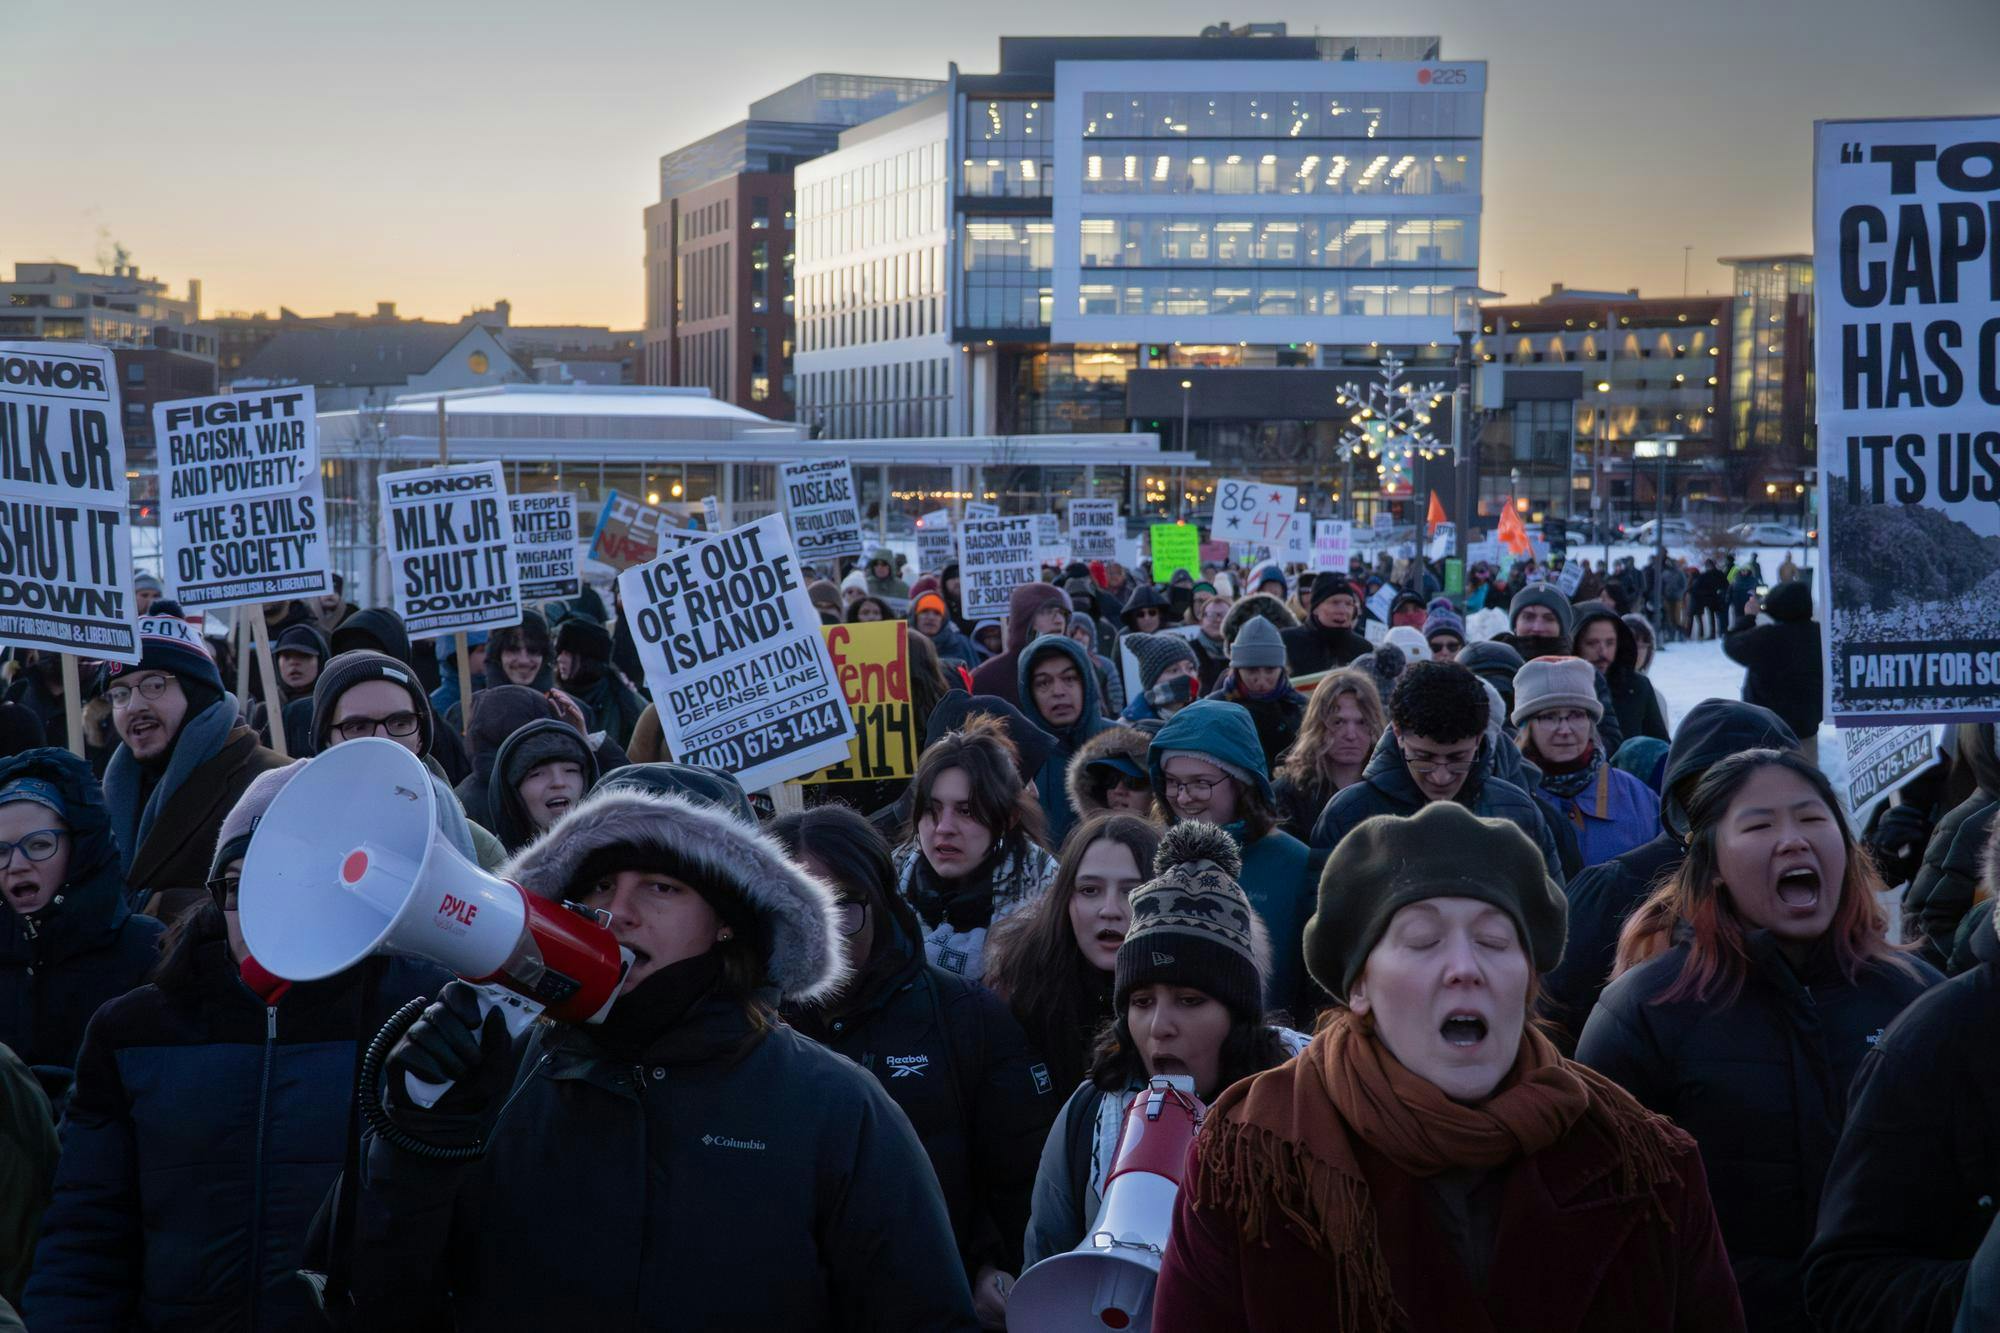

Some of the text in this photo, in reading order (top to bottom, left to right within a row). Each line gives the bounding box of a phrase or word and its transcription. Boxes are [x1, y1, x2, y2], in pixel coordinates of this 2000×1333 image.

[1432, 68, 1467, 85] 225
[0, 357, 106, 392] ONOR
[1842, 320, 1963, 410] HAS
[166, 394, 303, 432] FIGHT
[61, 408, 115, 491] JR
[169, 420, 305, 466] RACISM, WAR
[171, 455, 305, 499] AND POVERTY:
[786, 459, 846, 476] RACISM
[1846, 433, 1926, 506] ITS
[390, 474, 493, 498] HONOR
[790, 478, 851, 507] DISEASE
[1221, 483, 1259, 511] 86
[174, 496, 316, 544] “THE 3 EVILS
[524, 496, 571, 511] PEOPLE
[609, 496, 679, 532] ICE
[1088, 511, 1114, 527] KING
[393, 498, 500, 552] MLK JR
[529, 530, 573, 543] DEFEND
[798, 530, 859, 547] CURE!
[964, 519, 1030, 534] FIGHT
[1007, 531, 1032, 546] WAR
[1252, 511, 1291, 540] 47
[87, 509, 120, 586] IT
[178, 533, 317, 582] OF SOCIETY”
[516, 548, 573, 564] MIGRANT
[966, 551, 985, 566] AND
[986, 548, 1033, 565] POVERTY:
[403, 544, 507, 598] SHUT IT
[641, 526, 765, 605] ICE OUT
[994, 570, 1002, 585] 3
[1004, 567, 1035, 584] EVILS
[180, 574, 323, 601] PARTY FOR SOCIALISM & LIBERATION
[406, 586, 512, 615] DOWN!
[637, 555, 798, 643] OF RHODE
[968, 588, 982, 605] OF
[73, 625, 85, 642] &
[85, 624, 132, 648] LIBERATION
[141, 620, 191, 641] SOX
[661, 595, 794, 675] ISLAND!
[669, 638, 814, 715] DEPORTATION
[1850, 653, 1925, 689] PARTY
[1926, 652, 1973, 686] FOR
[677, 666, 820, 727] DEFENSE LINE
[685, 688, 829, 751] RHODE ISLAND
[744, 704, 838, 758] 675-1414
[1851, 734, 1929, 809] (401) 675-1414
[438, 893, 478, 927] PYLE
[886, 1054, 929, 1066] Reebok
[713, 1135, 767, 1151] Columbia
